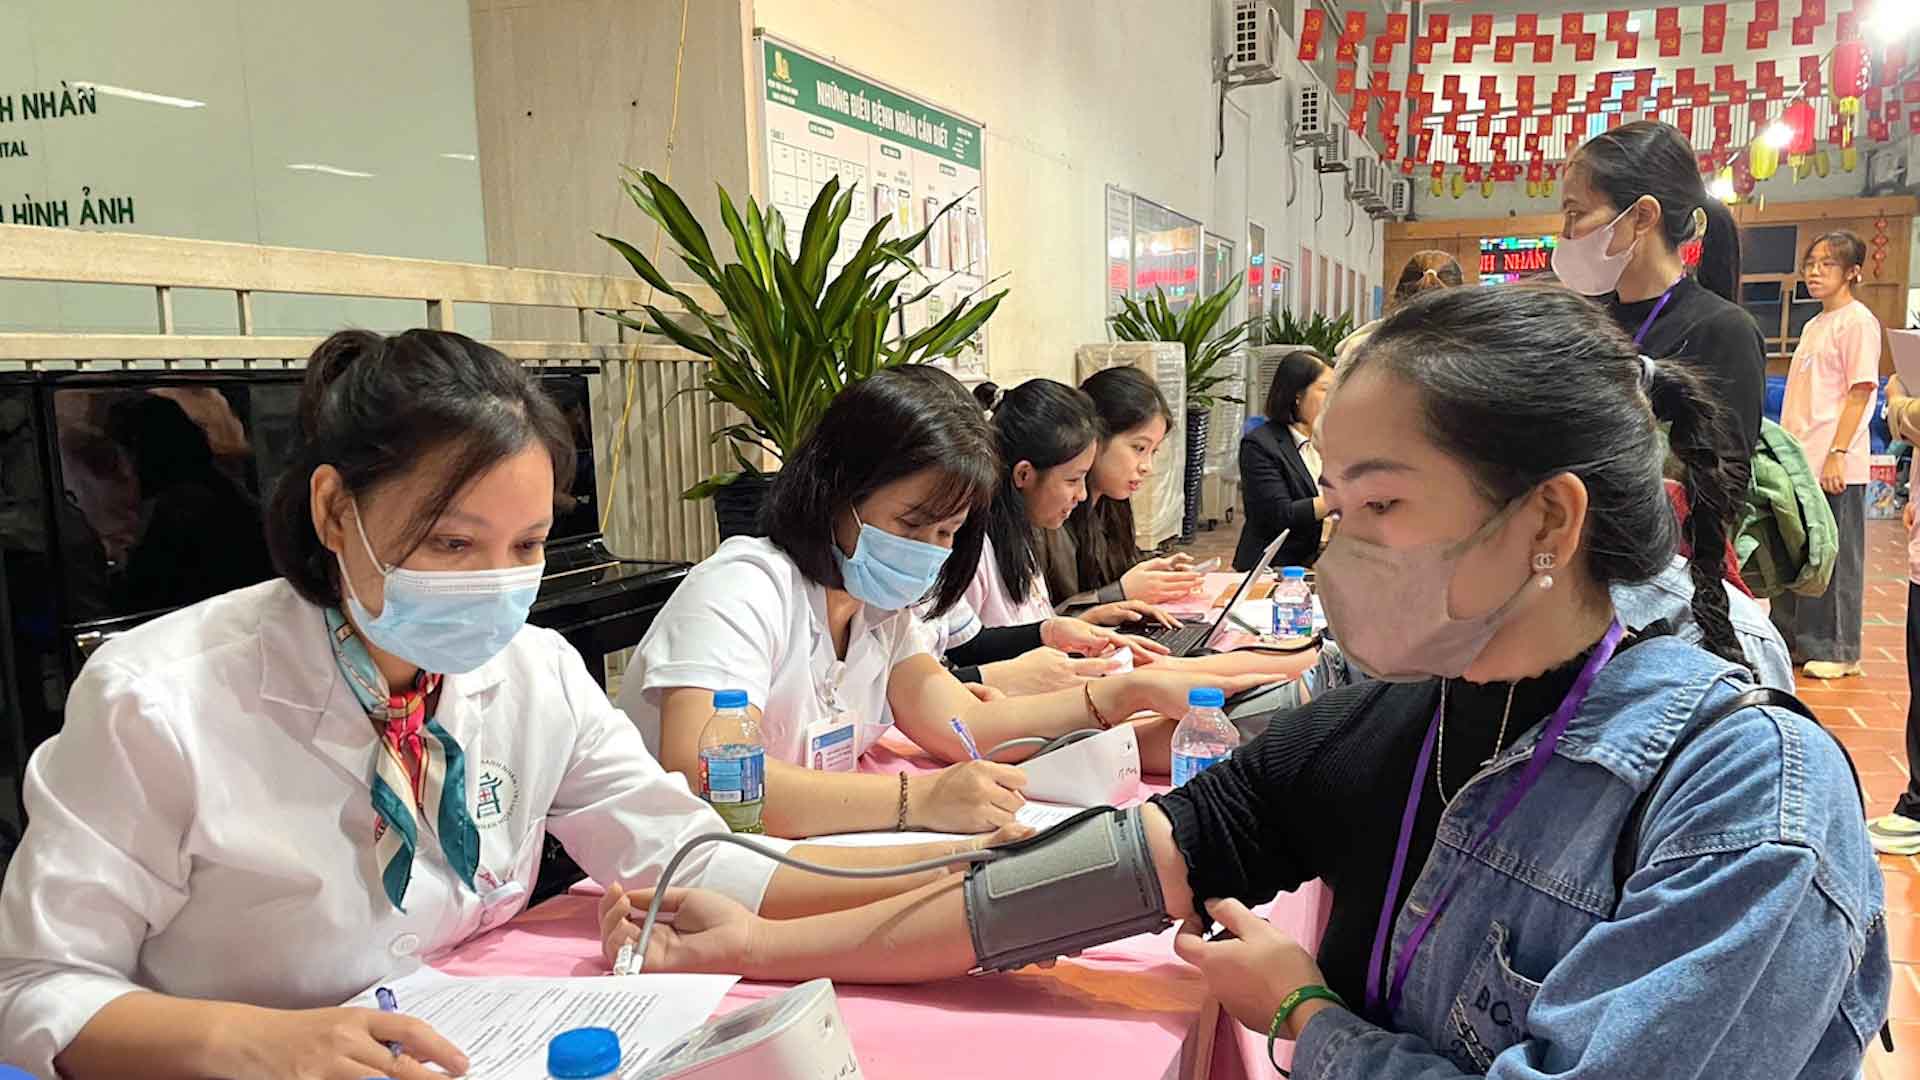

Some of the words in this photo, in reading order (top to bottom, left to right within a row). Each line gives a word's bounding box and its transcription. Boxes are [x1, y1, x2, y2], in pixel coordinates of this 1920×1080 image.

[22, 80, 97, 121] NHÀN
[12, 193, 69, 227] HÌNH
[79, 186, 135, 226] ẢNH
